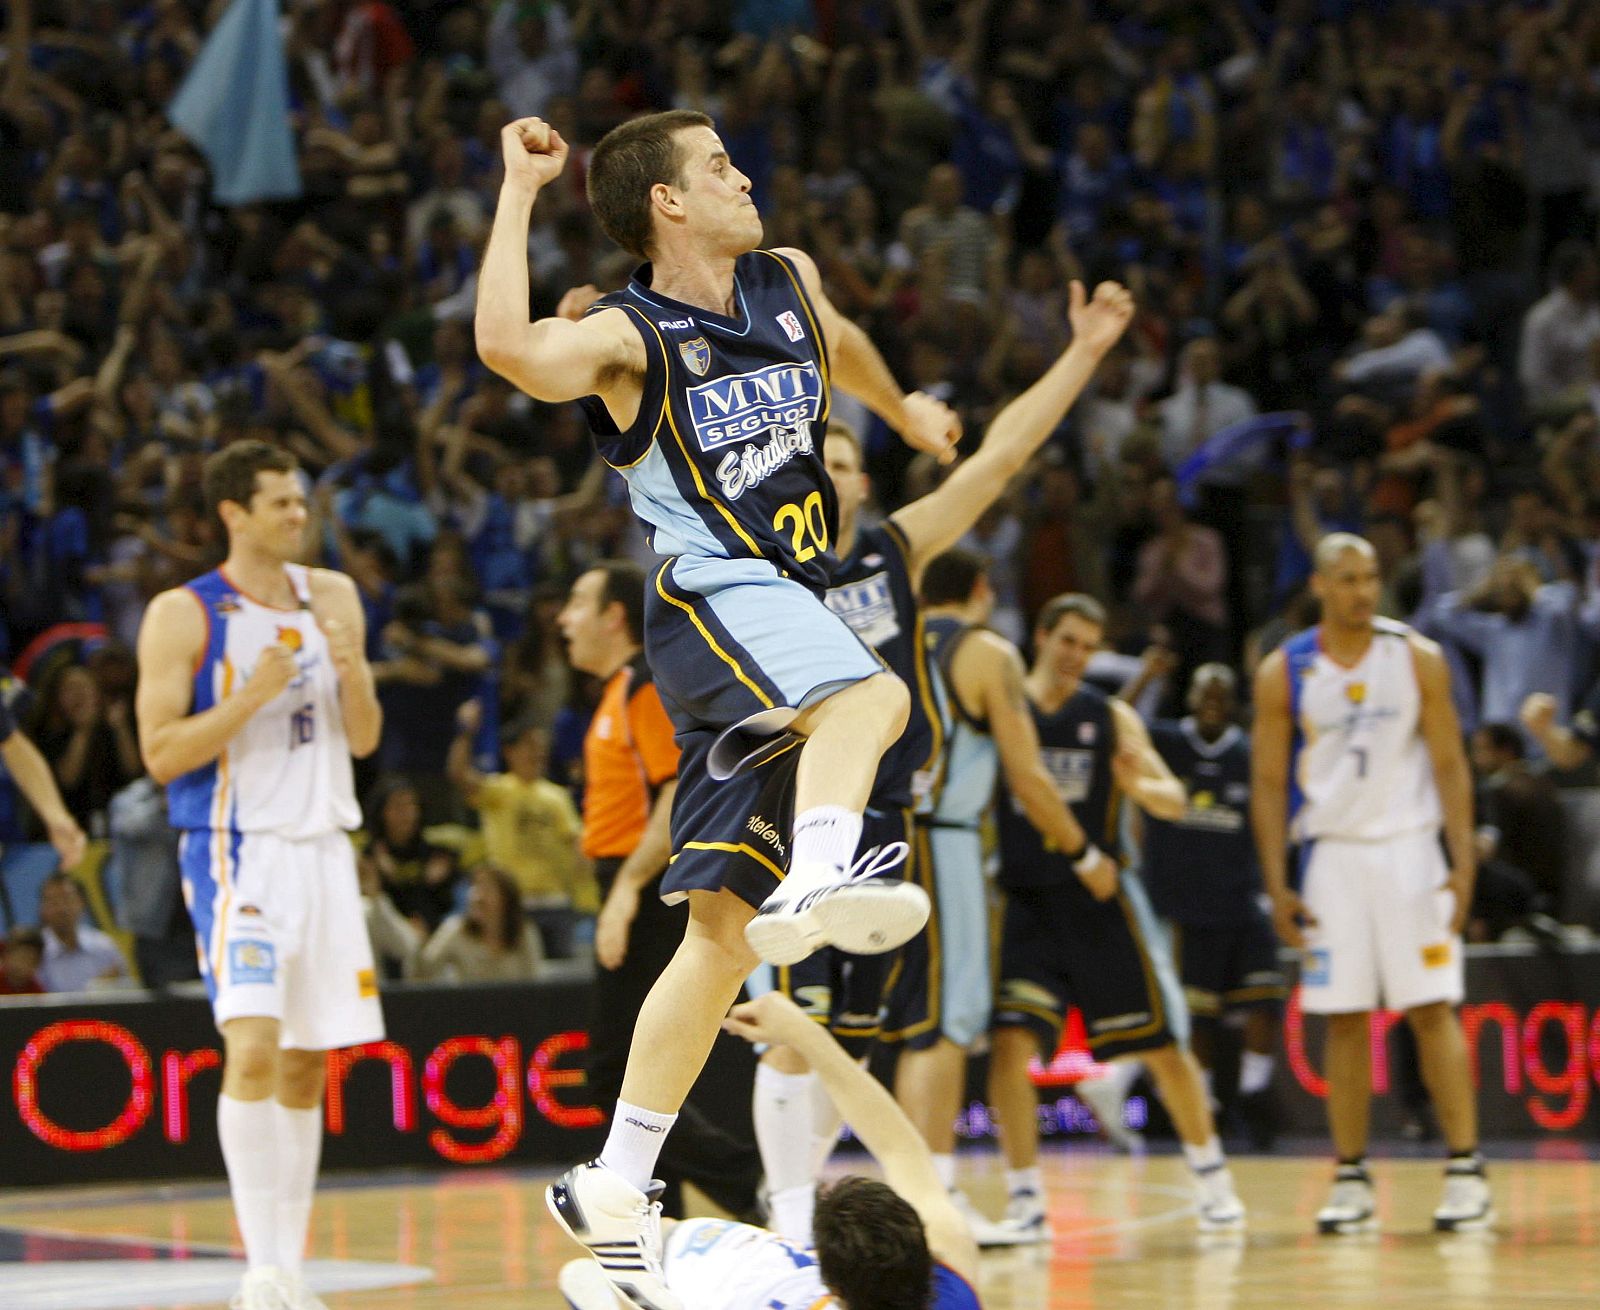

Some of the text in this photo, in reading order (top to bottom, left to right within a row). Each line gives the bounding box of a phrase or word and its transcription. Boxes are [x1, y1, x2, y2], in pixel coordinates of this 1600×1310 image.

[699, 367, 816, 420] MNT
[773, 491, 828, 563] 20
[290, 703, 315, 753] 16
[13, 1019, 606, 1162] Ornge
